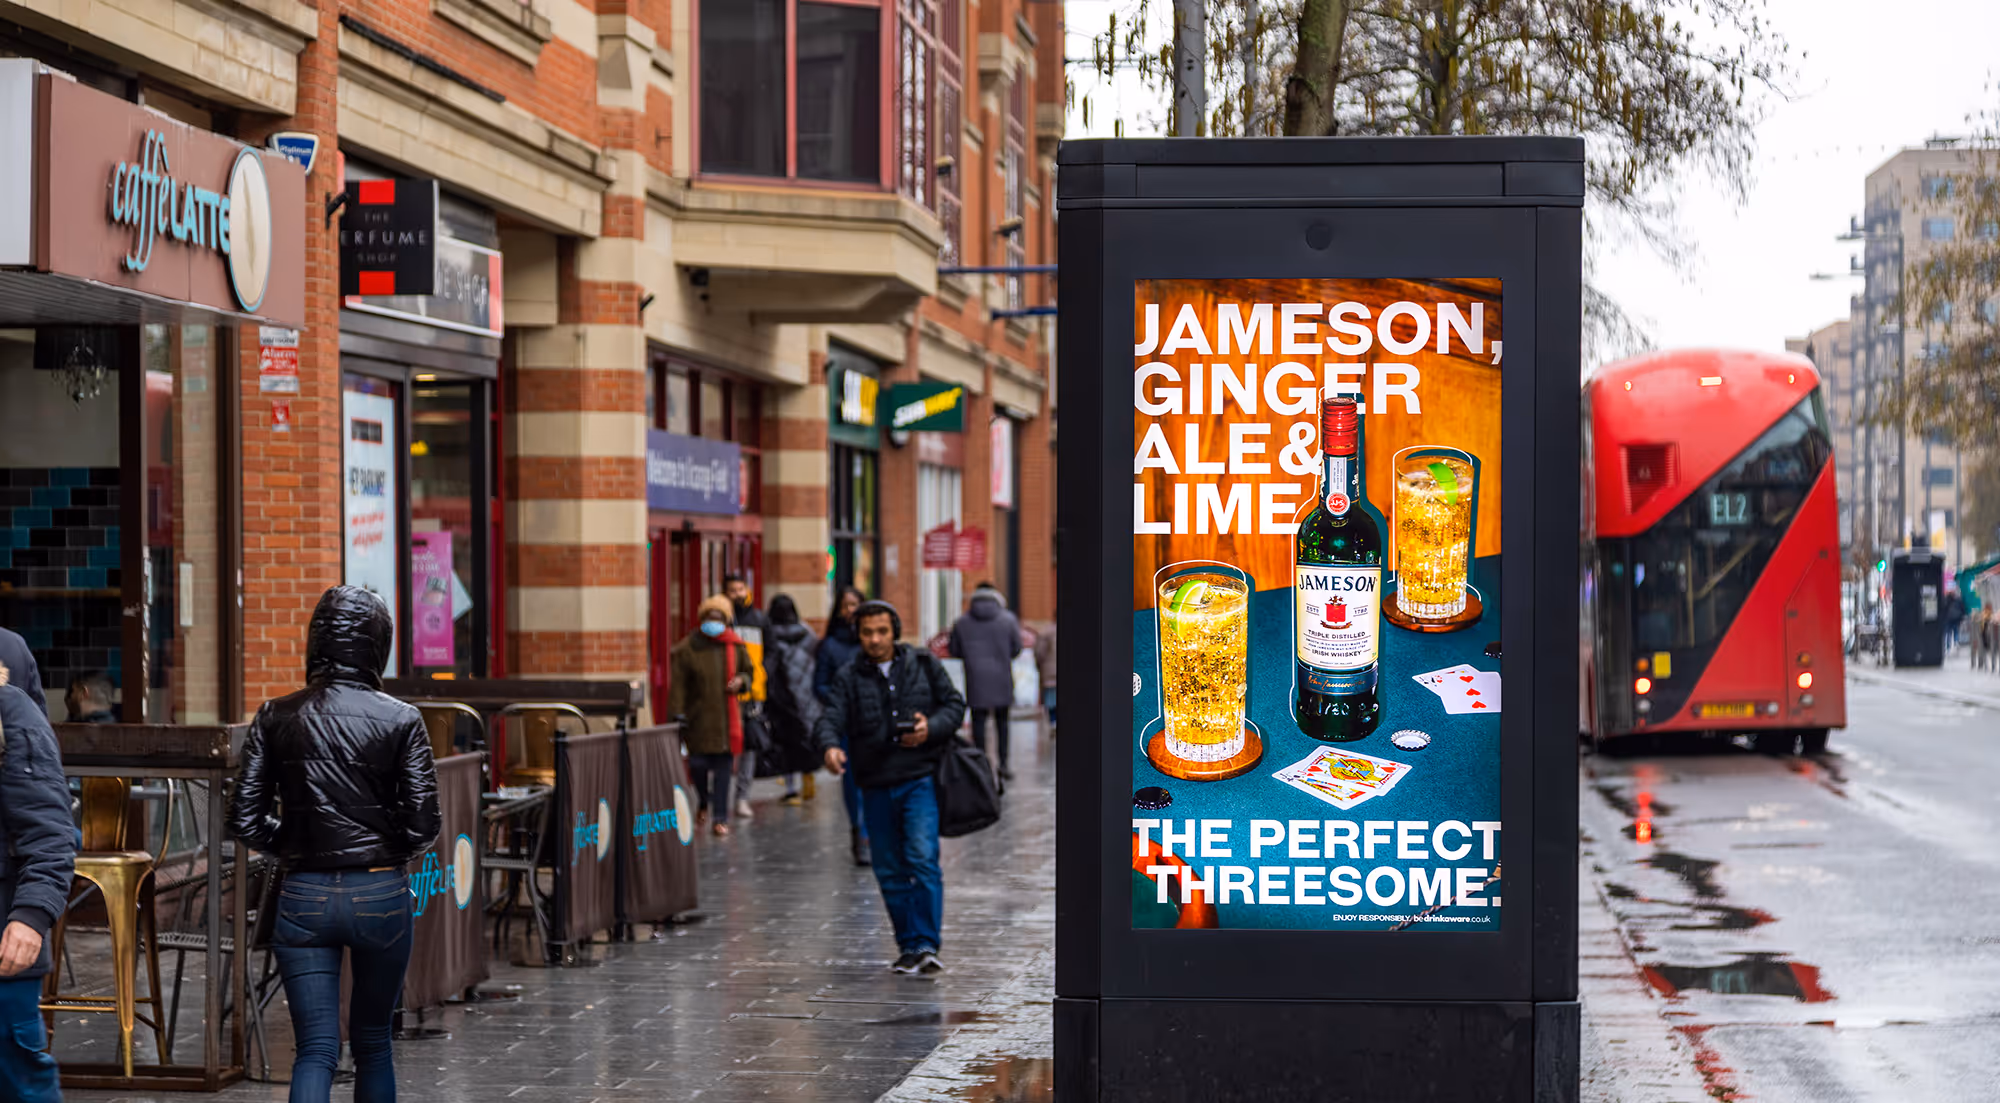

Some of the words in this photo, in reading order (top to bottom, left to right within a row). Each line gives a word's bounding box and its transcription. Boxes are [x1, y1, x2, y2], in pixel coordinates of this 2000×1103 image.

[364, 212, 390, 222] THE
[340, 230, 429, 246] ERFUME
[357, 253, 396, 263] SHOP
[1135, 301, 1502, 365] JAMESON,
[1134, 361, 1422, 416] GINGER
[1134, 422, 1272, 475] ALE
[1278, 421, 1323, 475] &
[1134, 483, 1302, 534] LIME
[1710, 493, 1747, 524] EL2
[1299, 574, 1376, 592] JAMESON
[1308, 629, 1330, 639] TRIPLE
[1331, 631, 1366, 639] DISTILLED
[1311, 648, 1330, 657] IRISH
[1330, 650, 1362, 658] WHISKEY
[1133, 818, 1232, 858] THE
[1250, 819, 1502, 860] PERFECT
[1146, 865, 1502, 907] THREESOME.
[1333, 914, 1357, 922] ENJOY
